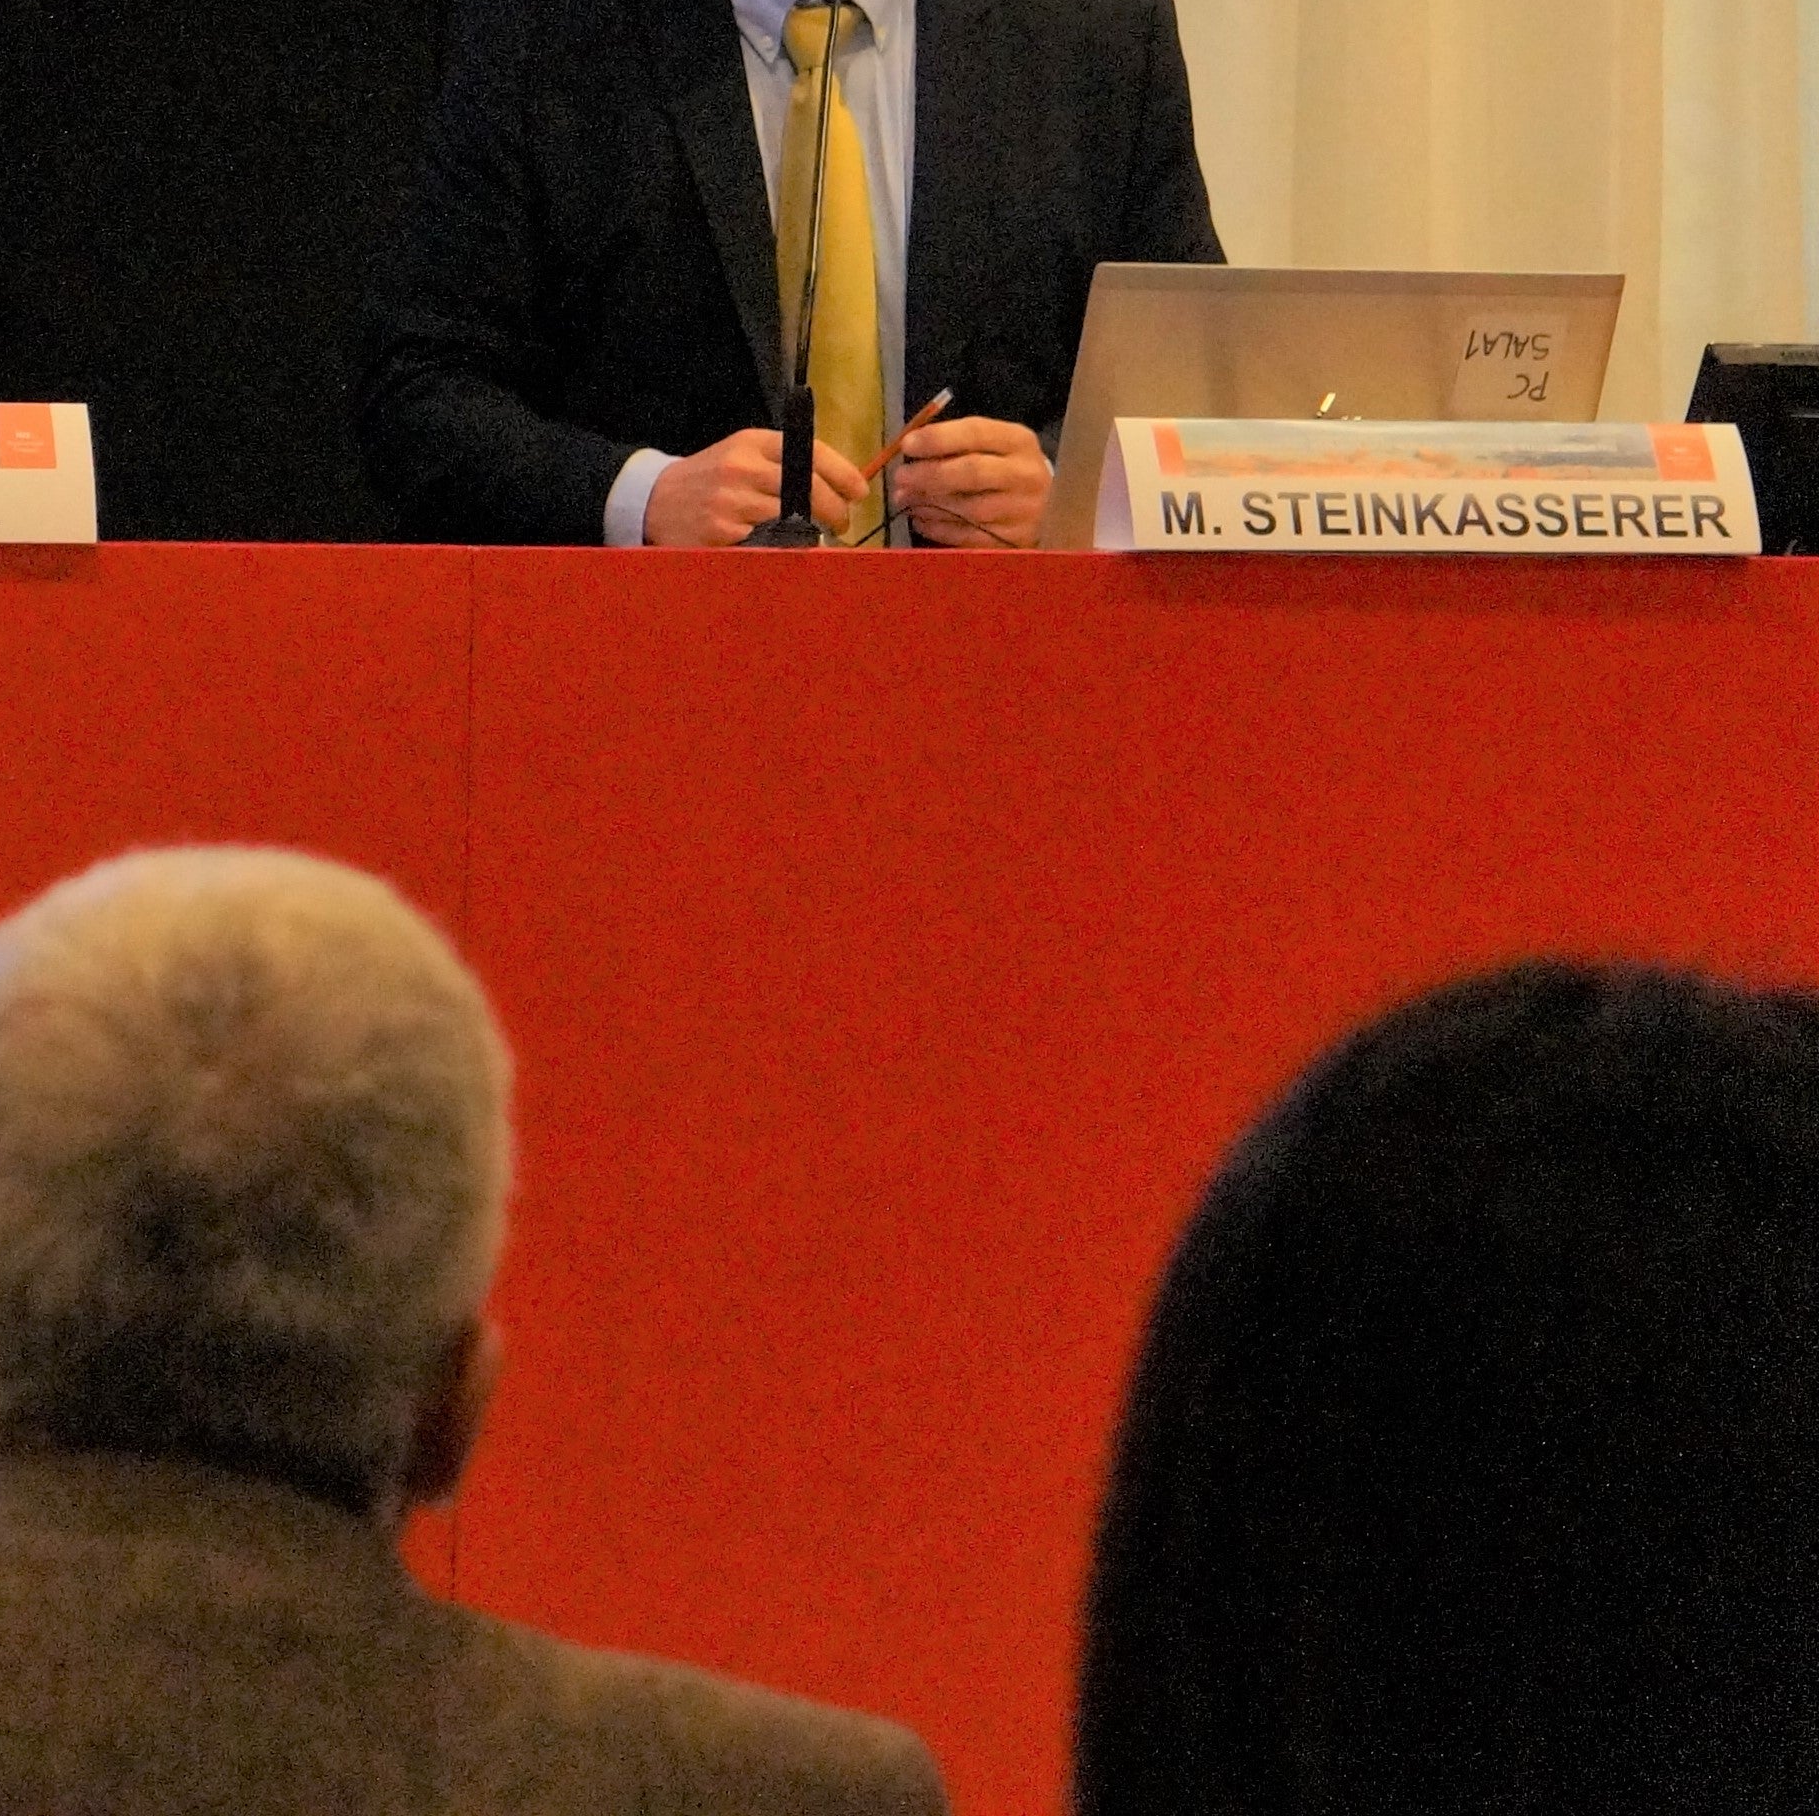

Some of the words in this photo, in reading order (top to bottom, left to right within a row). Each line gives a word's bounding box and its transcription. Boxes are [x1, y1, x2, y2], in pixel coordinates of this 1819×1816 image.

[1507, 371, 1549, 401] PC
[1162, 491, 1222, 537] M.
[1244, 490, 1732, 539] STEINKASSERER
